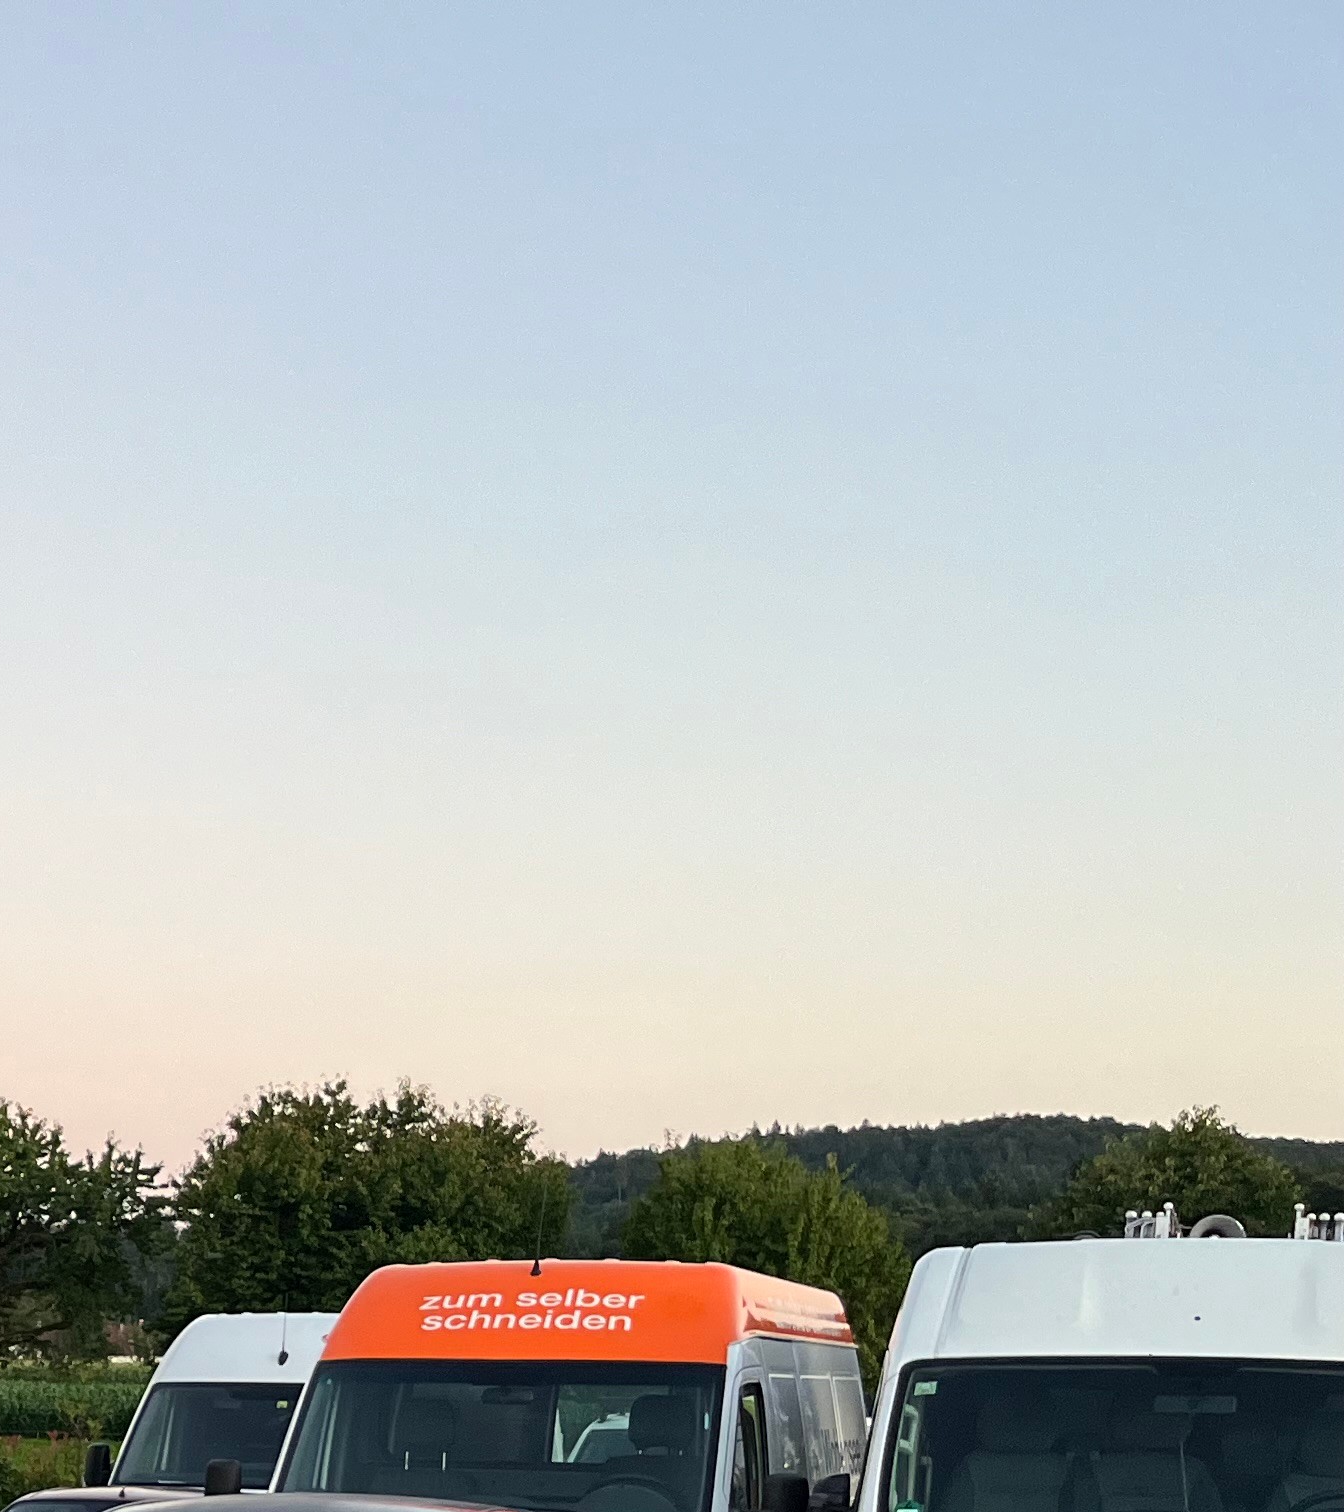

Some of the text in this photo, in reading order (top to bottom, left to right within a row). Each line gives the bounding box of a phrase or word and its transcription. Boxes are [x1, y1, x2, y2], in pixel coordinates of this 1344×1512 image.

[418, 1287, 646, 1311] zum selber
[420, 1309, 633, 1332] schneiden
